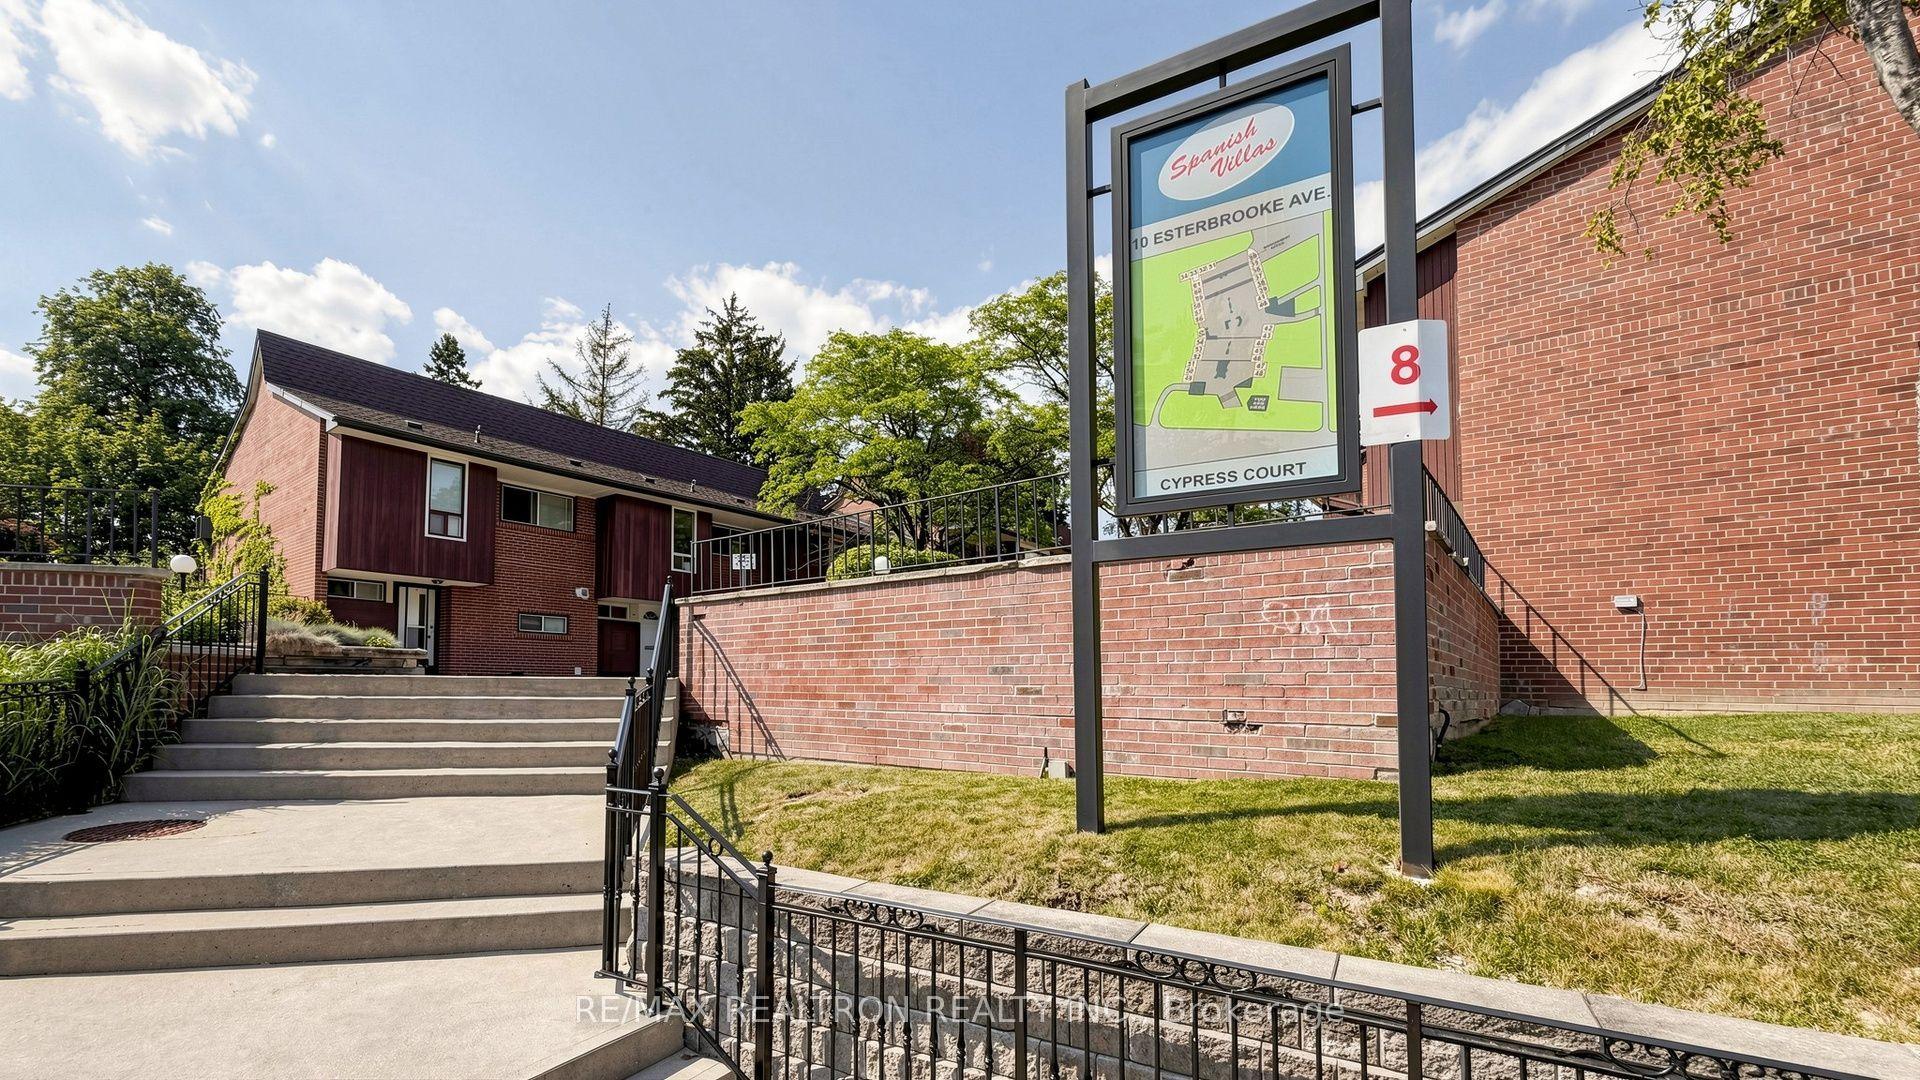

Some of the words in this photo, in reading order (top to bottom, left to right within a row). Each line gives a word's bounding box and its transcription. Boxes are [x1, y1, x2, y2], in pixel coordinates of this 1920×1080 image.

[1170, 117, 1257, 180] Spanish
[1210, 138, 1278, 178] Villas
[1131, 236, 1149, 250] 10
[1153, 198, 1284, 246] ESTERBROOKE
[1288, 186, 1332, 209] AVE.
[1391, 345, 1421, 385] 8
[1160, 470, 1238, 491] CYPRESS
[1243, 462, 1307, 481] COURT
